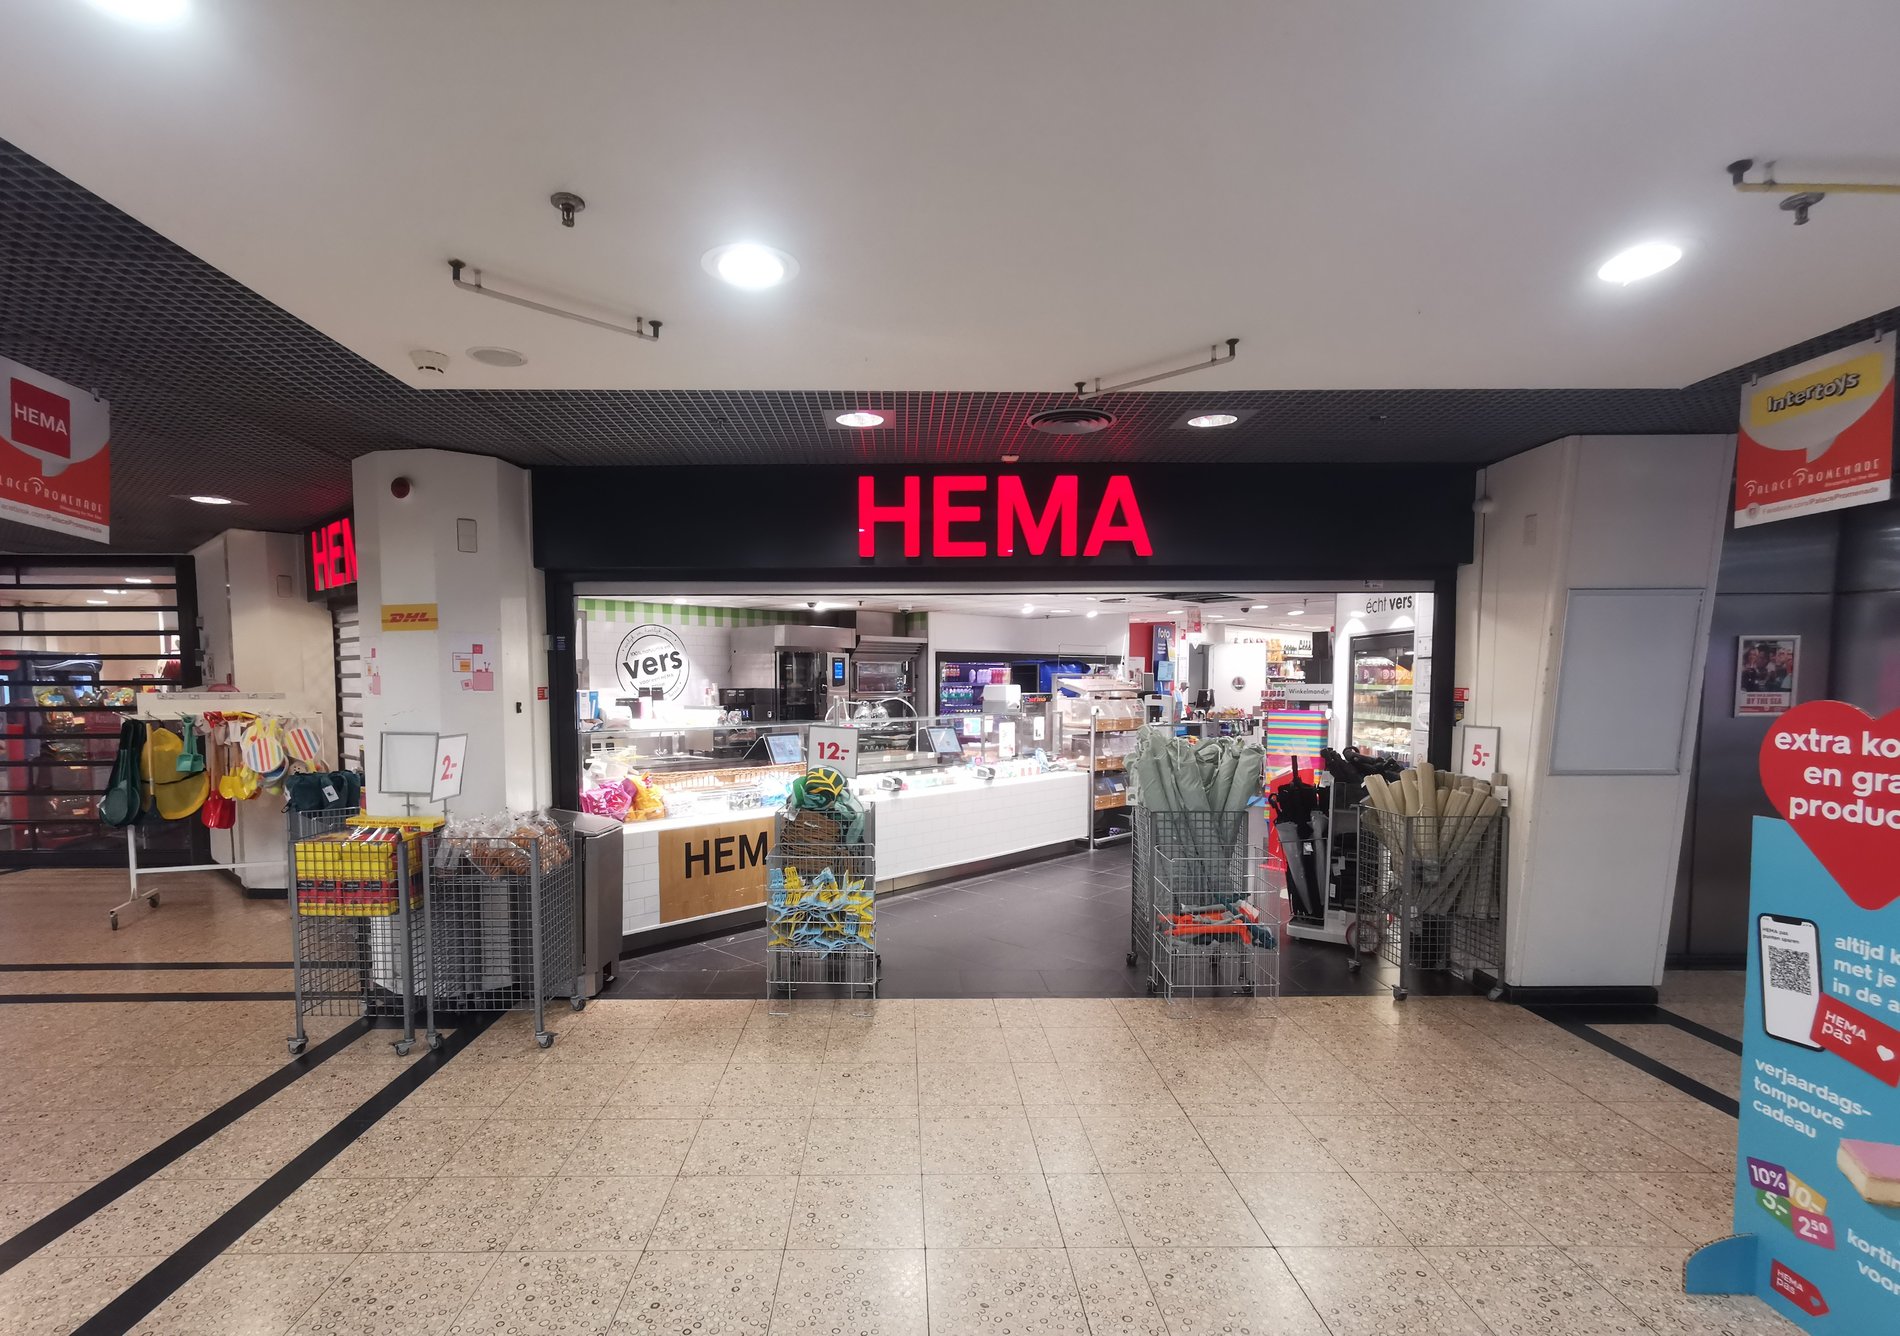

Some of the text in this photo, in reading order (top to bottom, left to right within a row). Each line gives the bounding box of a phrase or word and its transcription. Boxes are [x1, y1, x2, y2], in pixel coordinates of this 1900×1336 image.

[1767, 373, 1861, 413] Intertoys
[14, 402, 68, 436] HEMA
[858, 475, 1153, 558] HEMA
[389, 612, 429, 623] DHL
[1365, 595, 1412, 614] écht vers
[1157, 627, 1171, 638] foto
[622, 650, 683, 680] vers
[1288, 687, 1330, 696] Winkelmandje
[1774, 727, 1900, 758] extra ko
[1803, 766, 1842, 787] en
[1789, 796, 1900, 831] produc
[1834, 936, 1885, 961] altijd
[1833, 958, 1897, 988] met je
[1832, 977, 1851, 997] in
[1855, 987, 1883, 1007] de
[1821, 1021, 1853, 1045] pas
[1824, 1010, 1868, 1041] HEMA
[1754, 1058, 1872, 1117] verjaardags-
[1753, 1076, 1845, 1130] tompouce
[1752, 1099, 1817, 1138] cadeau
[1750, 1164, 1787, 1191] 10%
[1776, 1277, 1797, 1296] pas
[1777, 1268, 1805, 1293] HEMA
